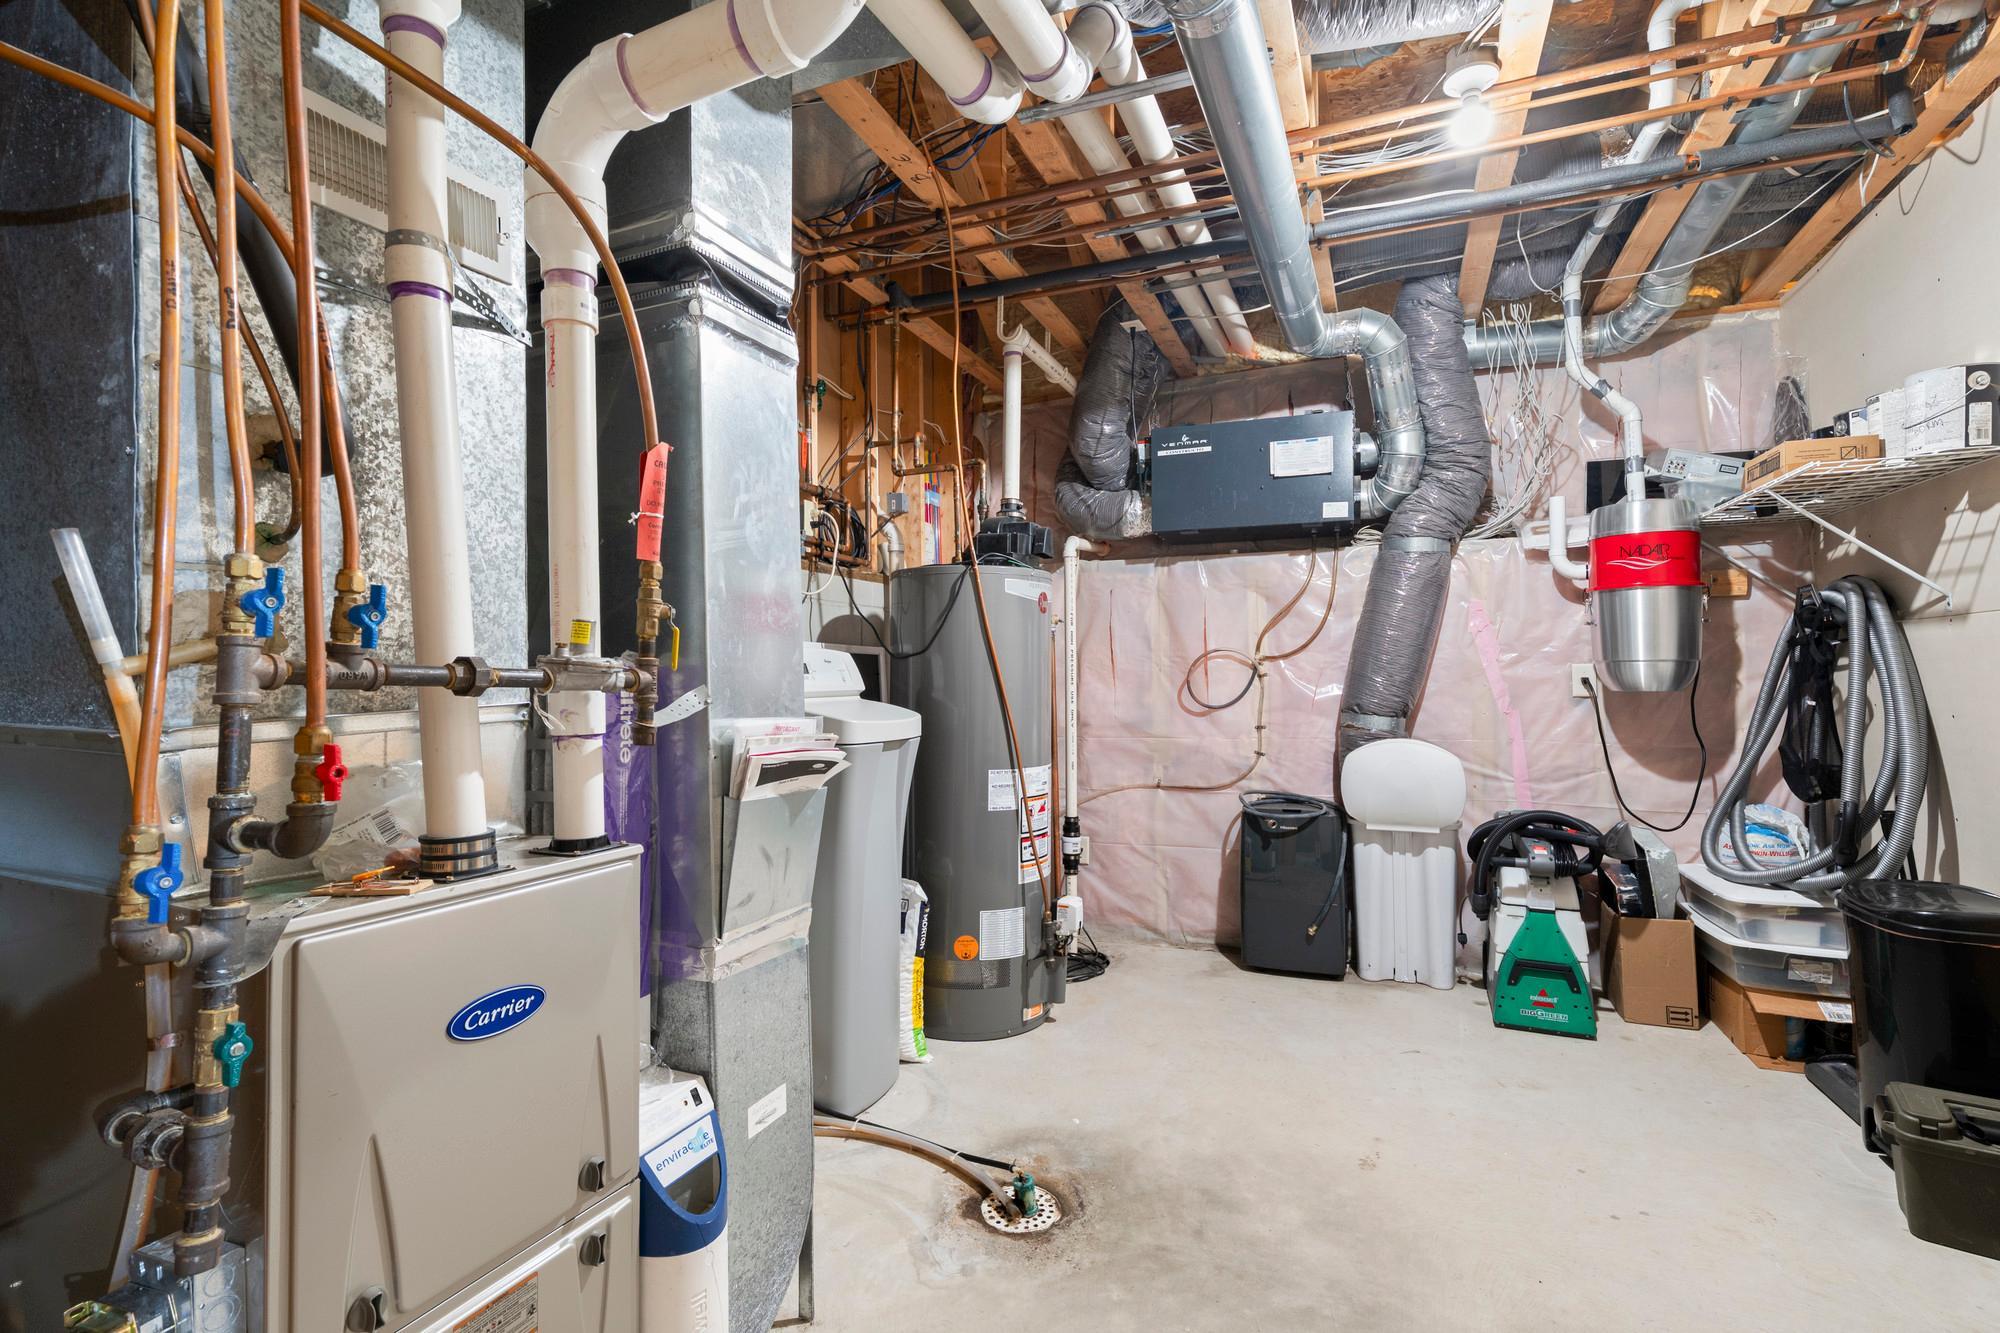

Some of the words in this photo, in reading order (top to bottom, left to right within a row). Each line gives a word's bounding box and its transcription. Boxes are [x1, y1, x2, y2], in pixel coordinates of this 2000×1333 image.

[1161, 439, 1209, 448] VENMAR
[919, 913, 929, 950] MORTON
[464, 995, 534, 1031] Carrier
